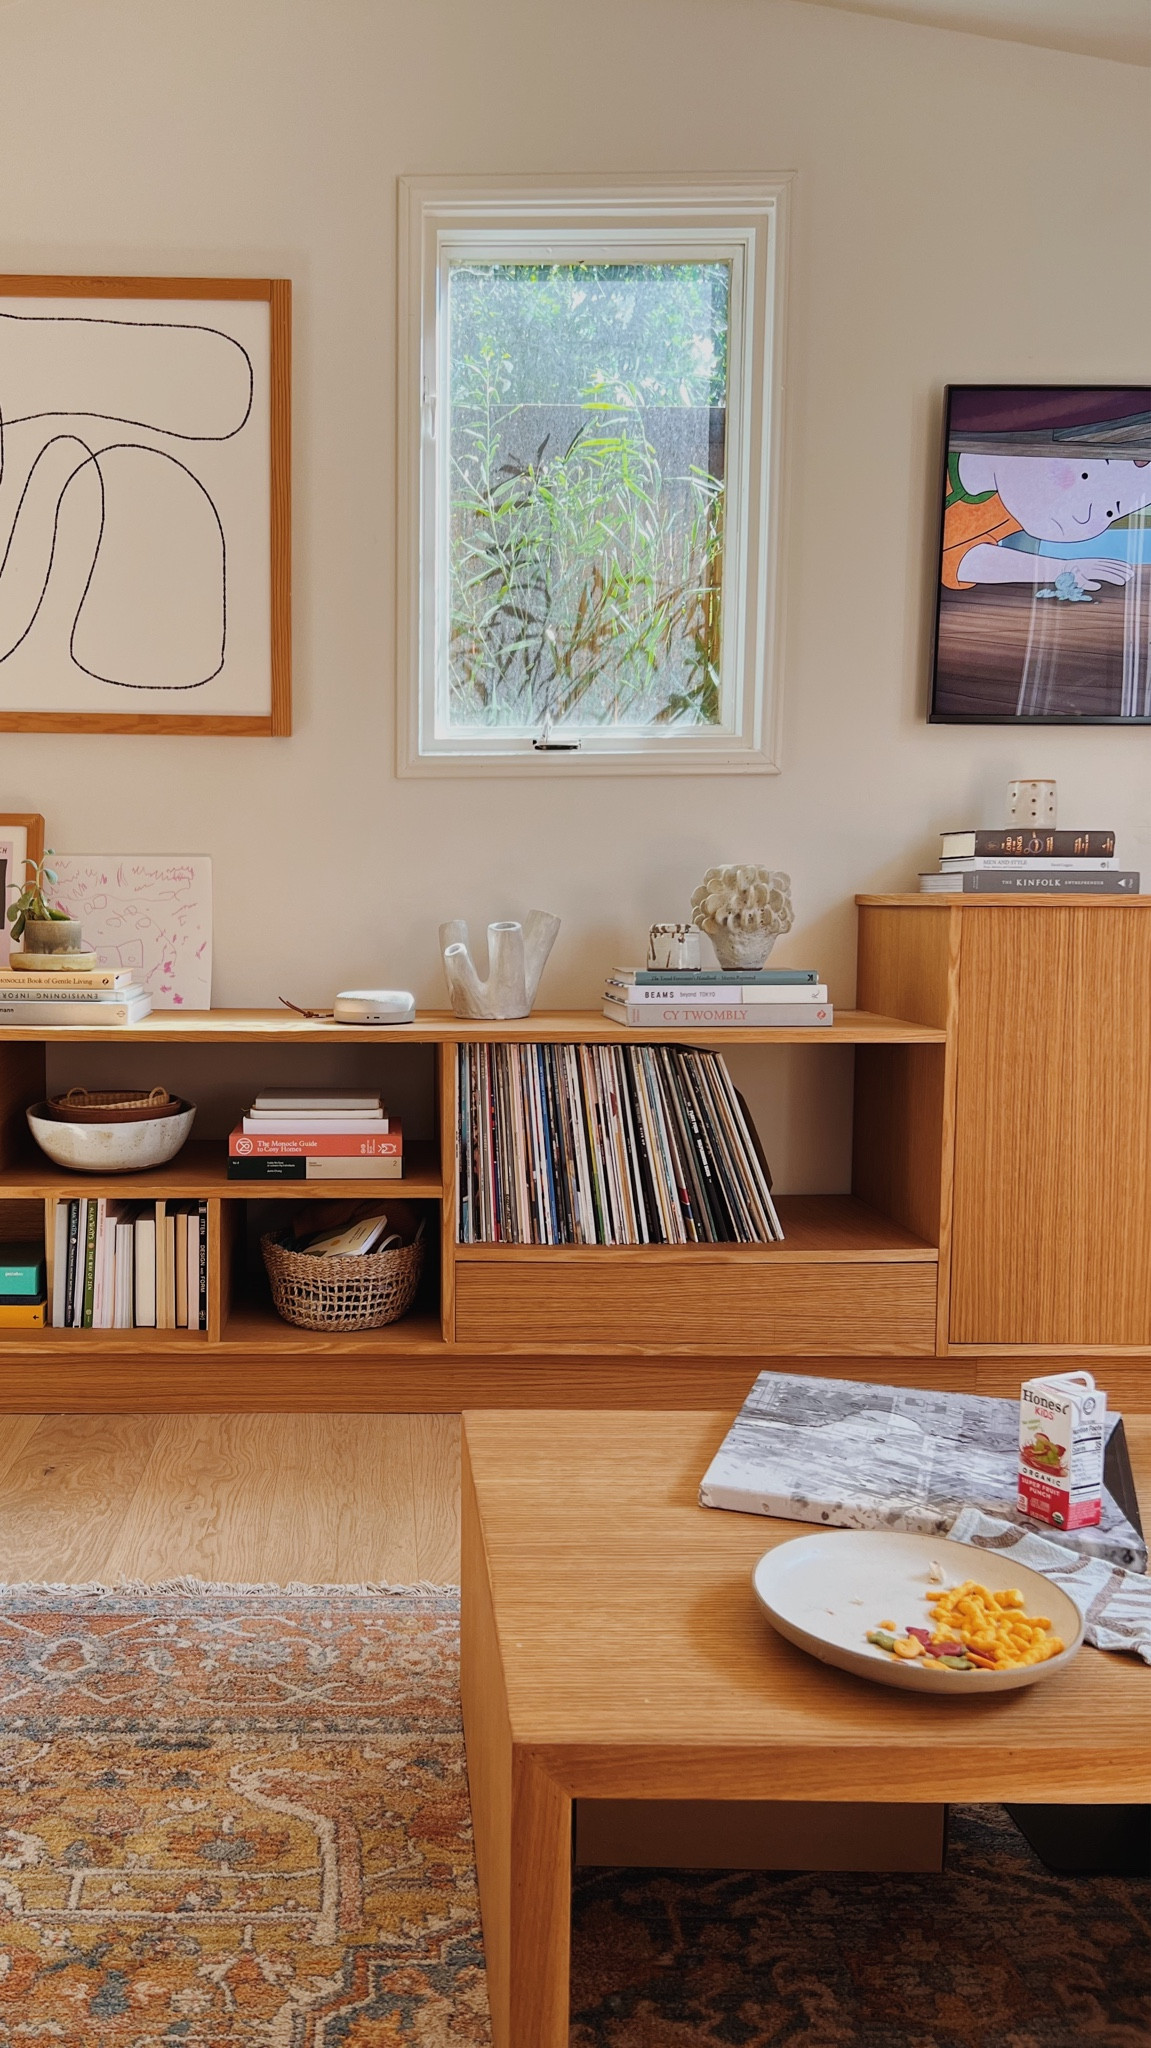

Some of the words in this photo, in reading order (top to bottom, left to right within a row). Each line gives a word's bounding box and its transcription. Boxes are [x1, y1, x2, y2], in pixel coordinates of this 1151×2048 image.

[663, 1010, 680, 1020] CY
[682, 1010, 749, 1020] TWOMBLY
[1022, 1388, 1070, 1415] Honest
[1034, 1406, 1054, 1420] KIDS
[1022, 1467, 1061, 1486] ORGANIC
[1021, 1476, 1041, 1488] SUPER
[1042, 1484, 1060, 1496] FRUIT
[1029, 1486, 1052, 1500] PUNCH
